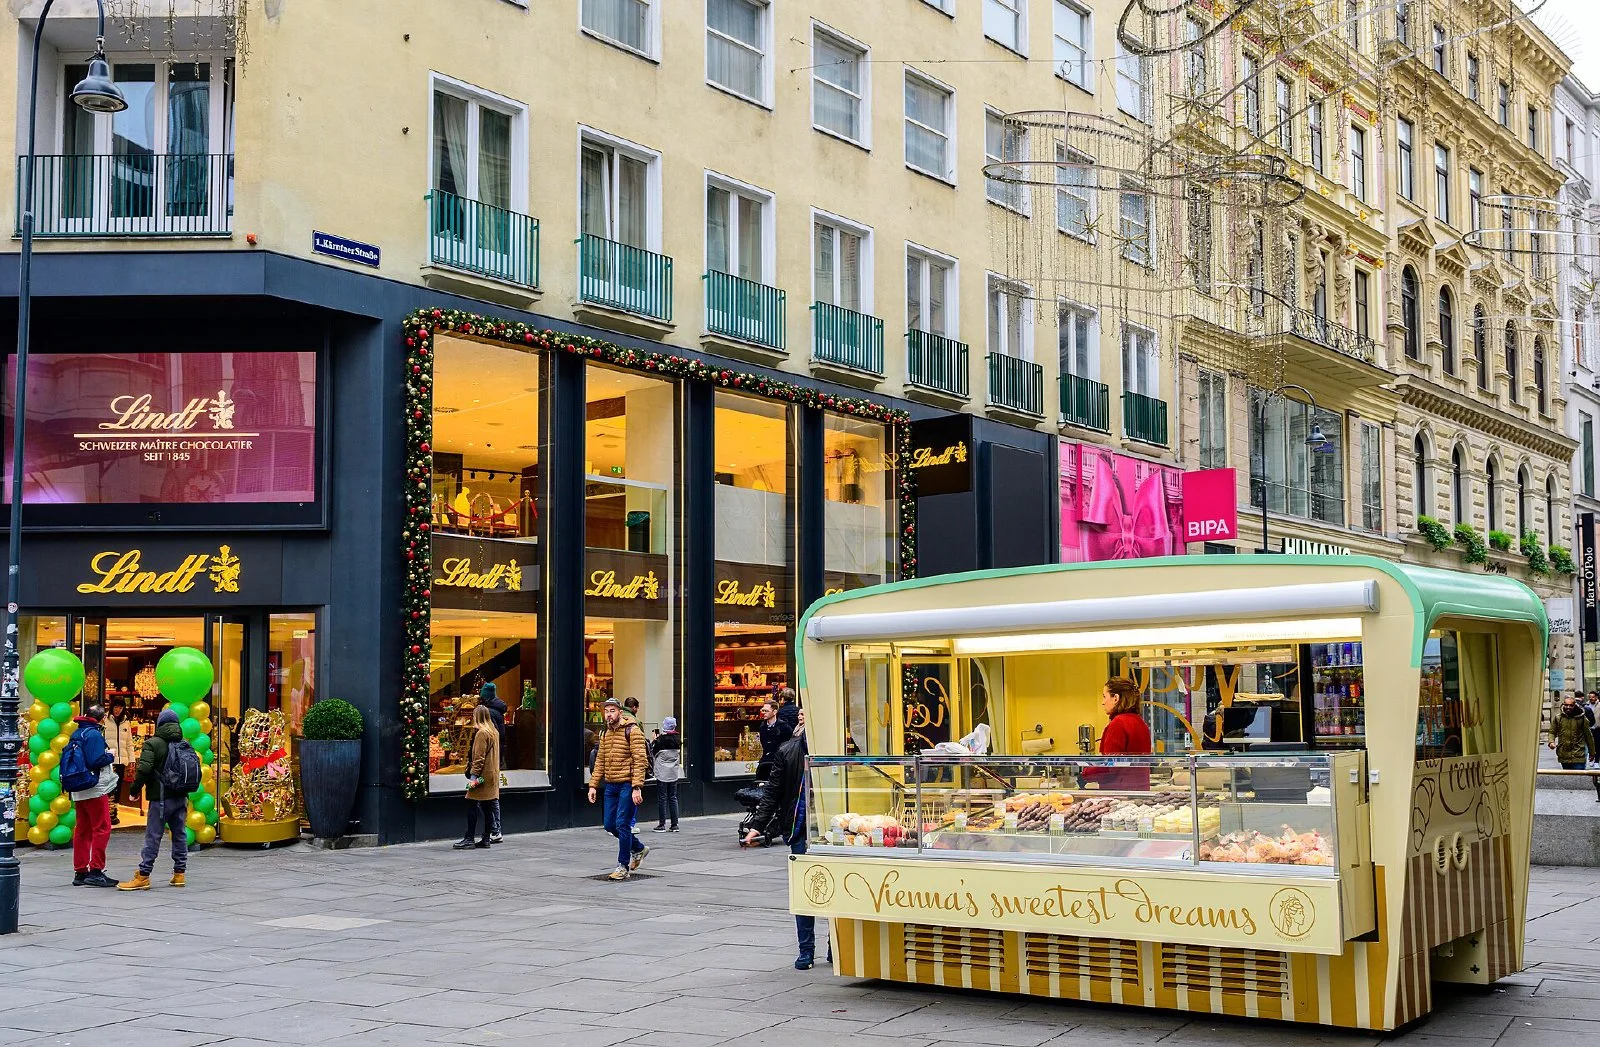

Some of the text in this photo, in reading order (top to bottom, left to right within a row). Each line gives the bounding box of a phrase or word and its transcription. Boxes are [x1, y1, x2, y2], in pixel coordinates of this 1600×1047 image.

[355, 247, 379, 260] Straße
[98, 393, 208, 430] Lindt
[79, 439, 253, 451] SCHWEIZER MAÎTRE CHOCOLATIER
[143, 452, 191, 461] SEIT 1845
[908, 446, 955, 469] Lindt
[1188, 518, 1230, 537] BIPA
[76, 549, 209, 594] Lindt
[434, 557, 506, 589] Lindt
[584, 570, 646, 599] Lindt
[1584, 546, 1595, 609] Marc O'Polo
[714, 580, 763, 606] Lindt
[843, 869, 1257, 936] Vienna's sweetest dreams
